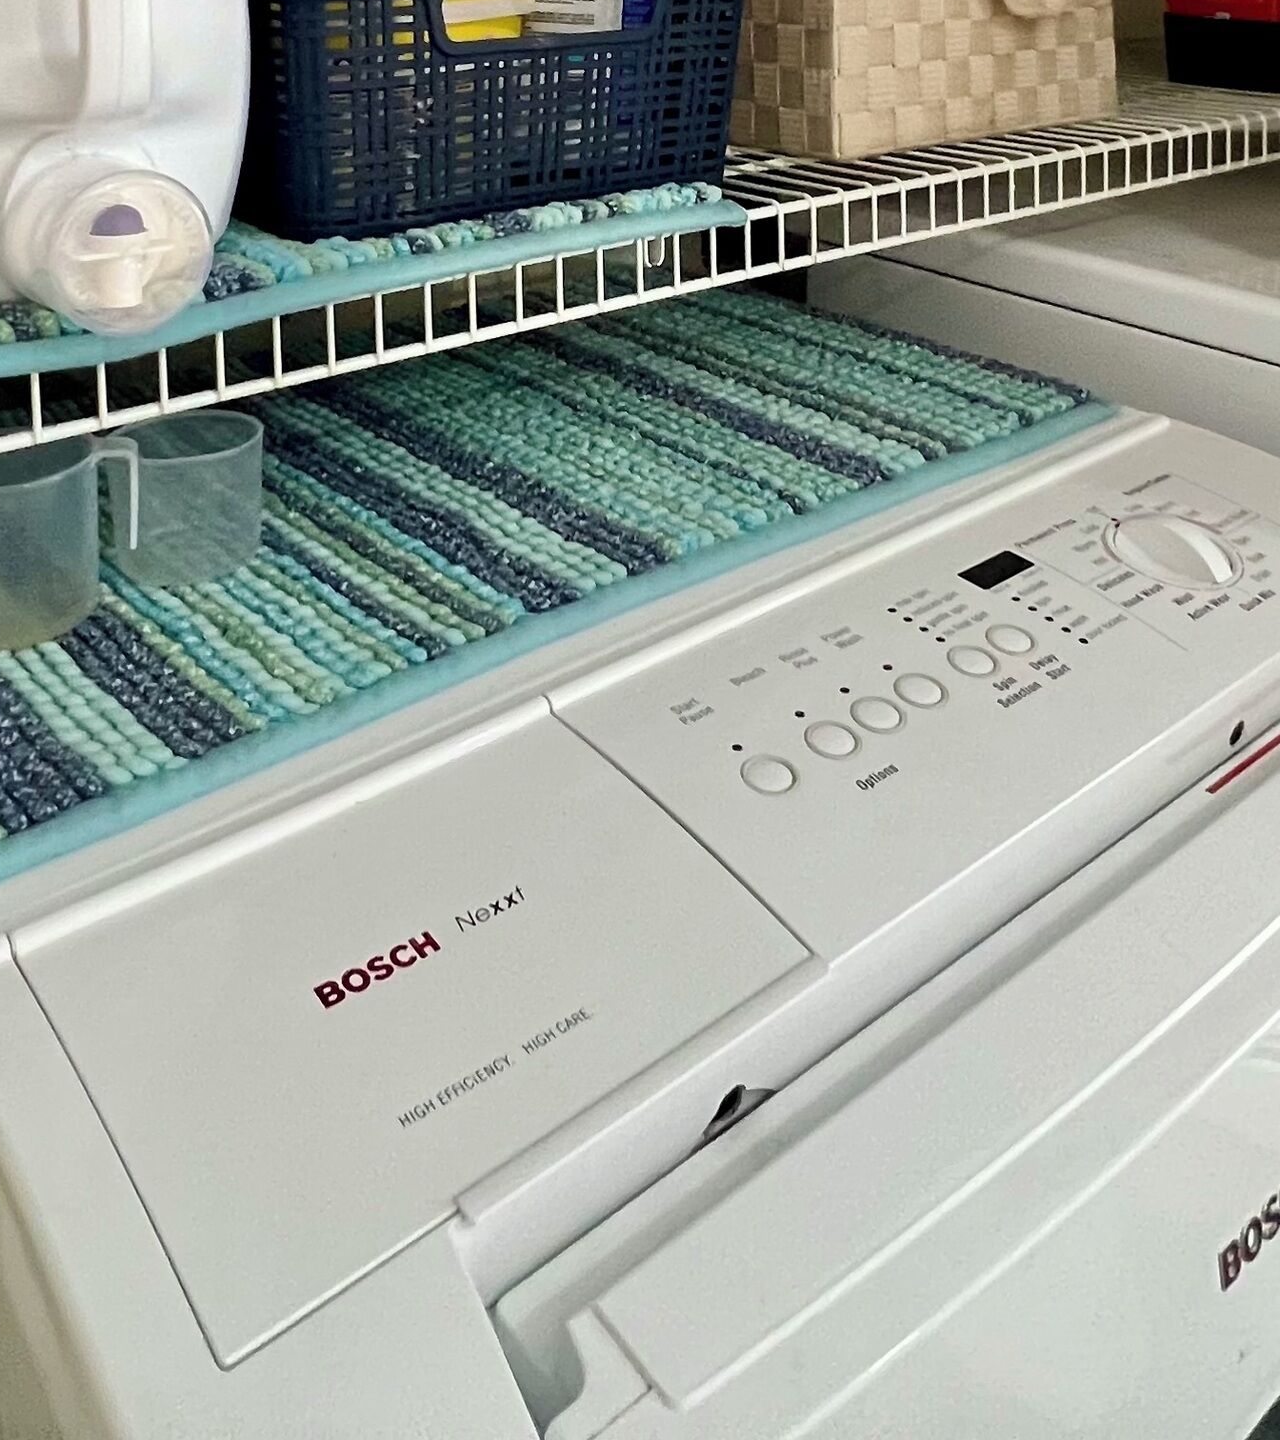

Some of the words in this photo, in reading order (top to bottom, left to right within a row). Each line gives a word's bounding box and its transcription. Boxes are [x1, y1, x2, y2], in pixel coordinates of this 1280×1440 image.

[855, 763, 900, 791] Options
[313, 930, 441, 1009] BOSCH
[454, 885, 526, 933] Nexxt
[398, 1098, 437, 1128] HIGH
[521, 1028, 557, 1055] HIGH
